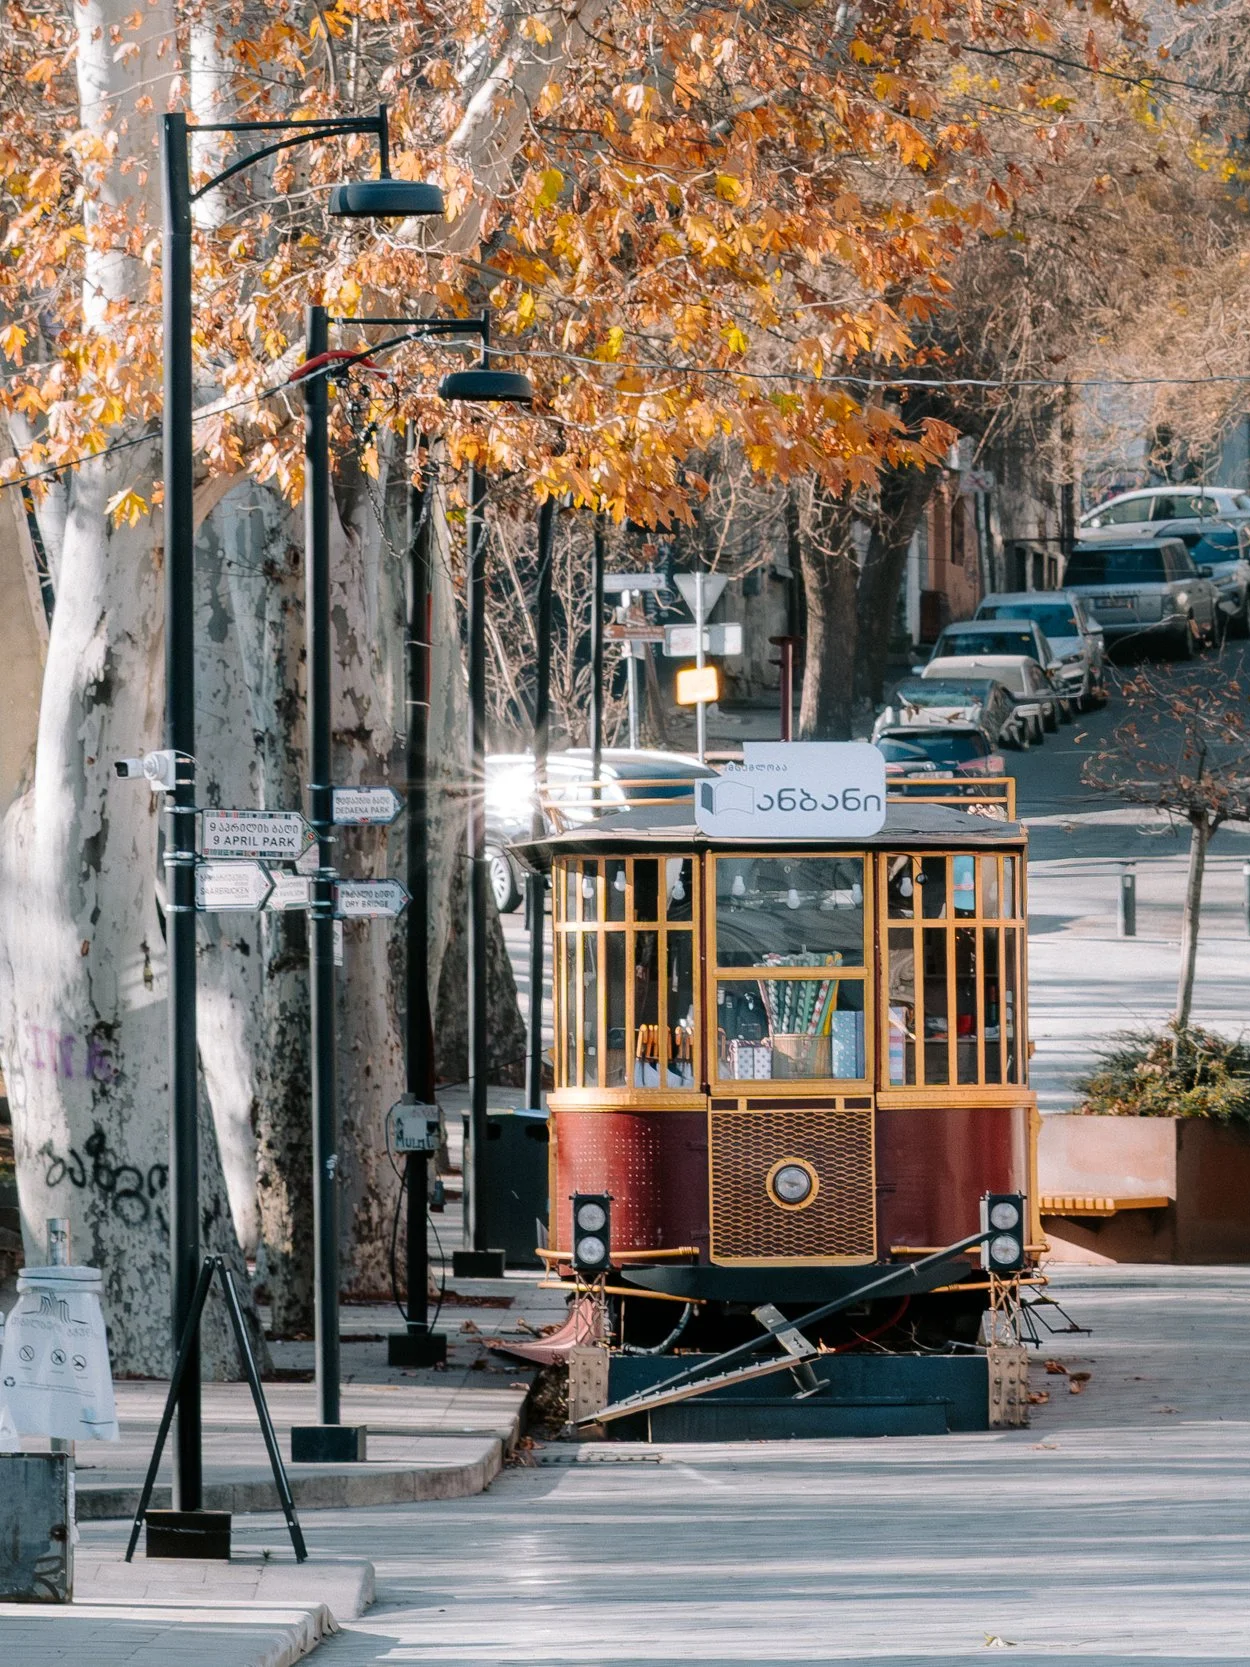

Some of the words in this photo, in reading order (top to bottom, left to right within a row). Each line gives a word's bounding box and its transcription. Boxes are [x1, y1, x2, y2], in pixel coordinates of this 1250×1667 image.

[756, 787, 881, 812] ანბანი
[335, 806, 369, 815] DEDAENA
[370, 806, 390, 814] PARK
[209, 822, 217, 832] 9
[219, 823, 270, 834] აპრილის
[271, 824, 299, 835] ბაღი
[213, 835, 220, 845] 9
[223, 836, 259, 847] APRIL
[262, 837, 296, 848] PARK
[345, 900, 360, 908] DRY
[361, 900, 389, 908] BRIDGE
